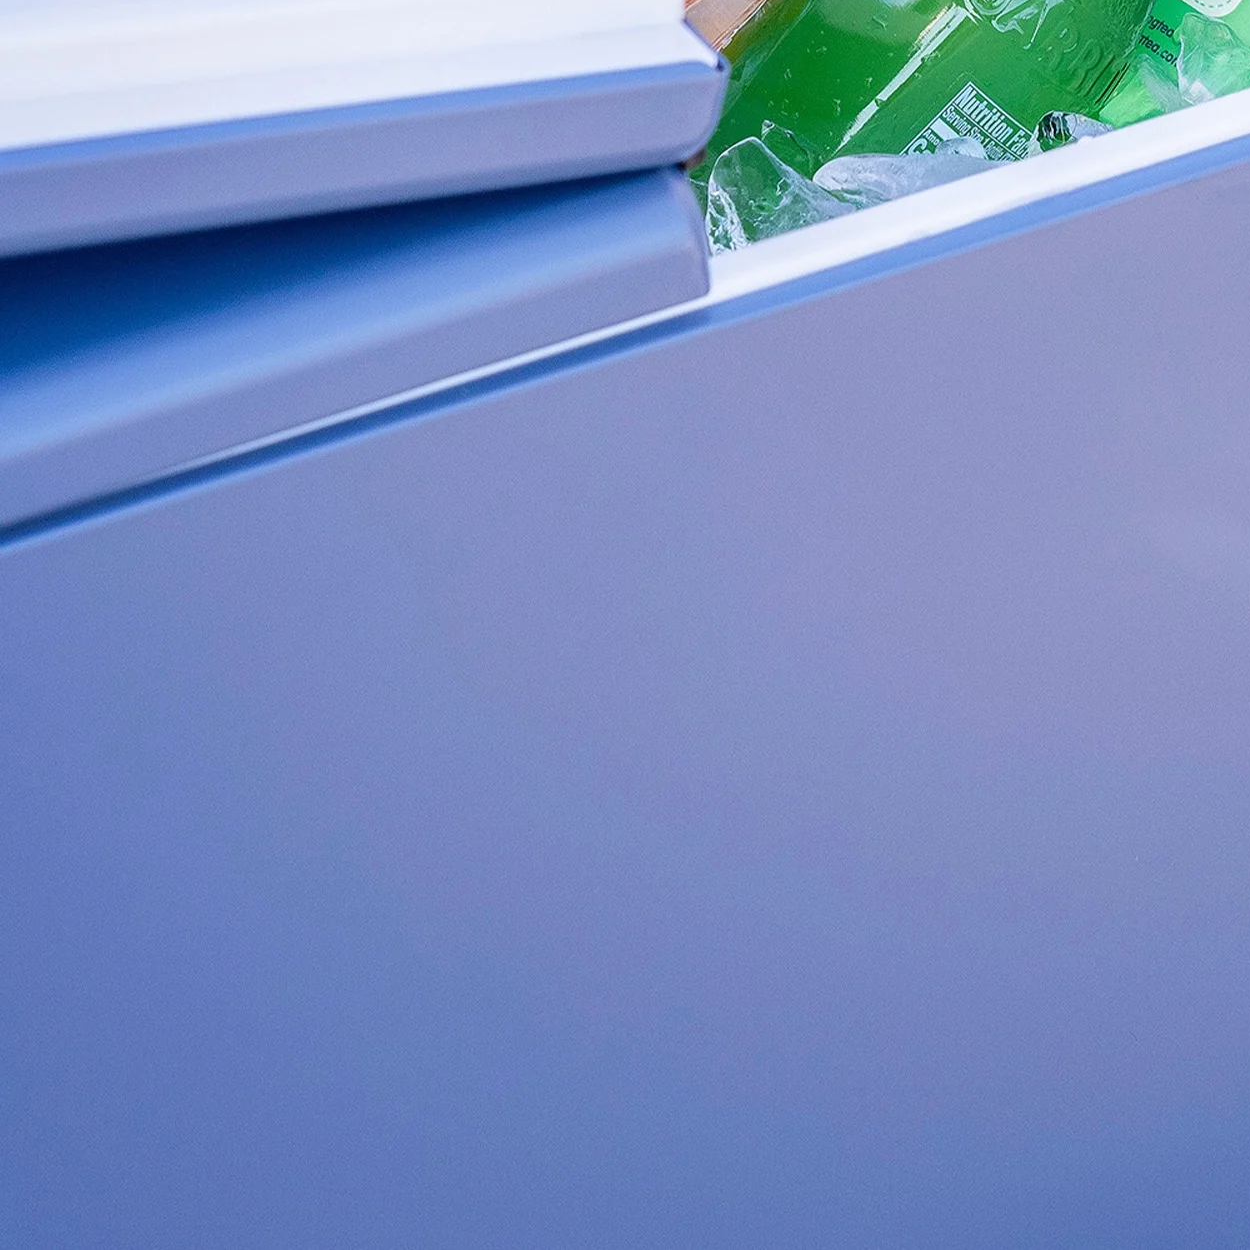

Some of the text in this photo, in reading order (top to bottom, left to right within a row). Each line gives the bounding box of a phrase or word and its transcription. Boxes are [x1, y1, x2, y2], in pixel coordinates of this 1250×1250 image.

[942, 106, 971, 136] Serving
[954, 86, 1013, 142] Nutrition
[923, 129, 940, 147] Amo
